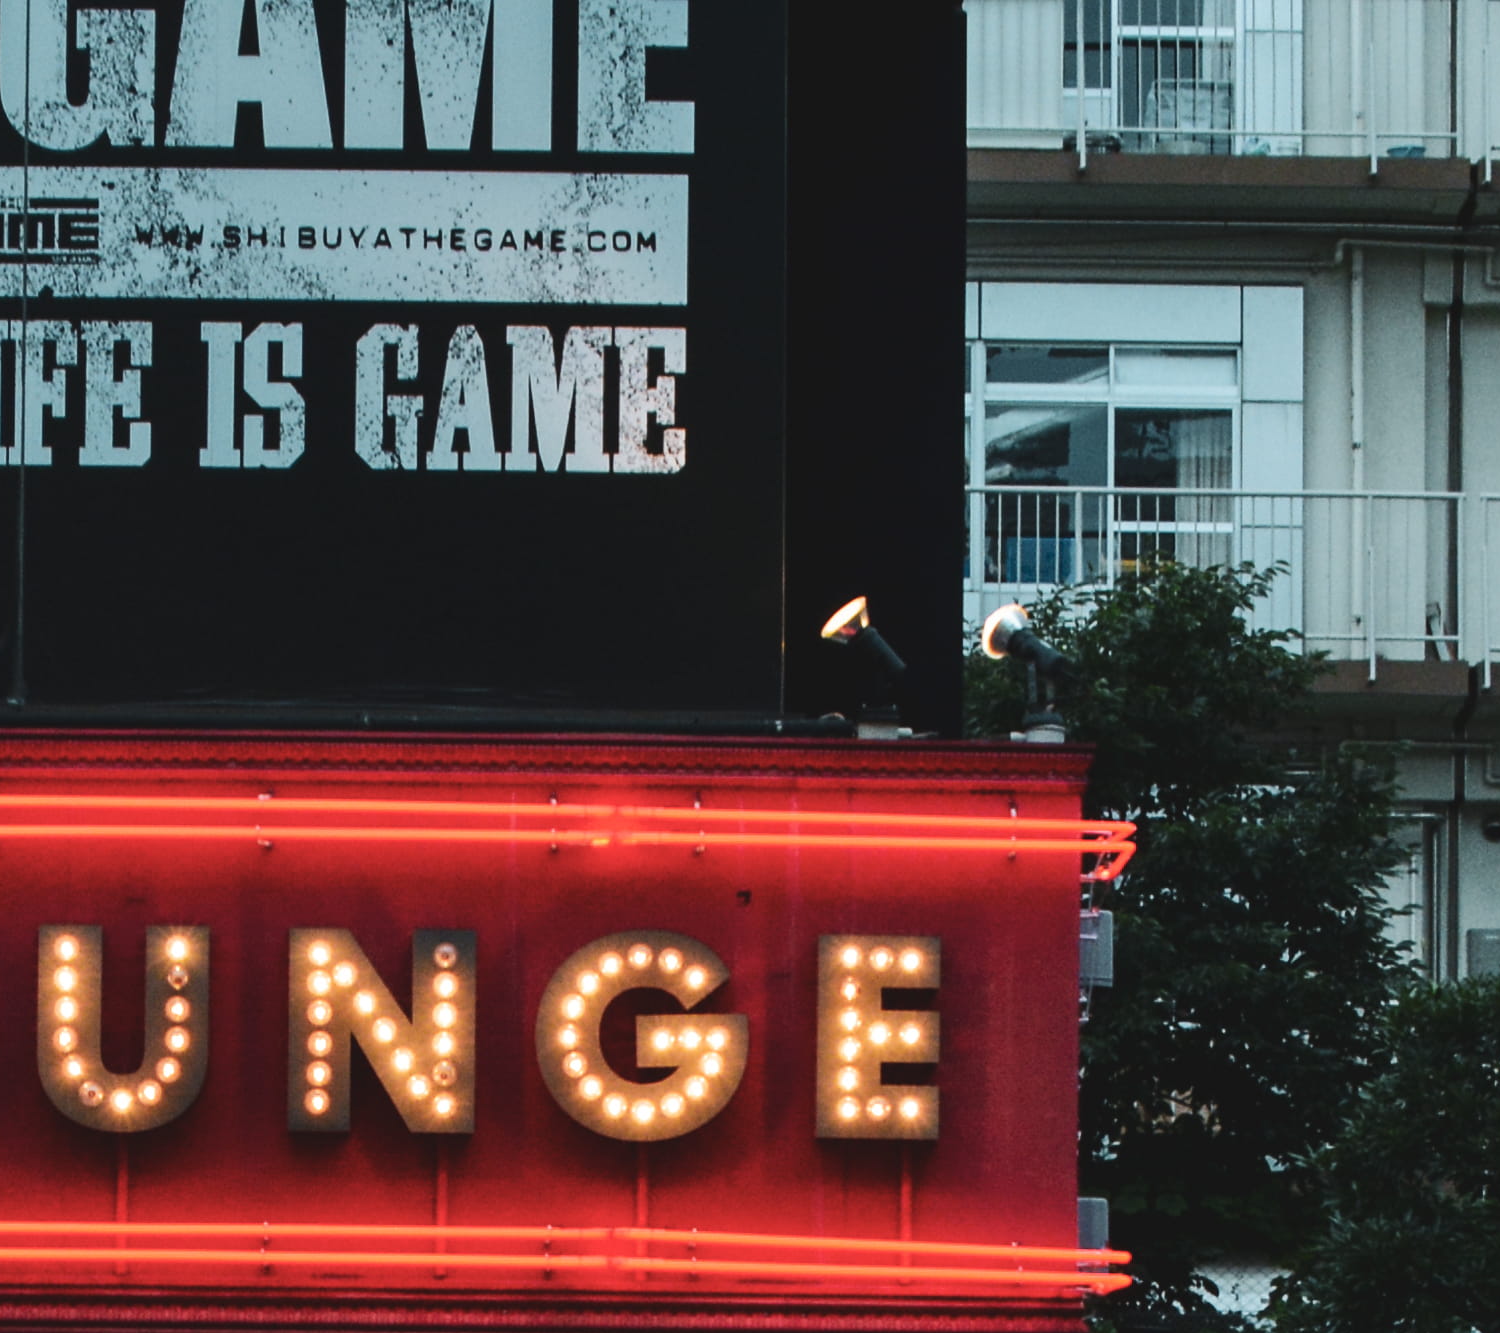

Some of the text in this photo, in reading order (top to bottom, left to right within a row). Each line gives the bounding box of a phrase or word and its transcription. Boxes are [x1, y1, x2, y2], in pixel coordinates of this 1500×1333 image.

[0, 0, 695, 152] GAME
[199, 320, 306, 468] IS
[355, 322, 688, 473] GAME
